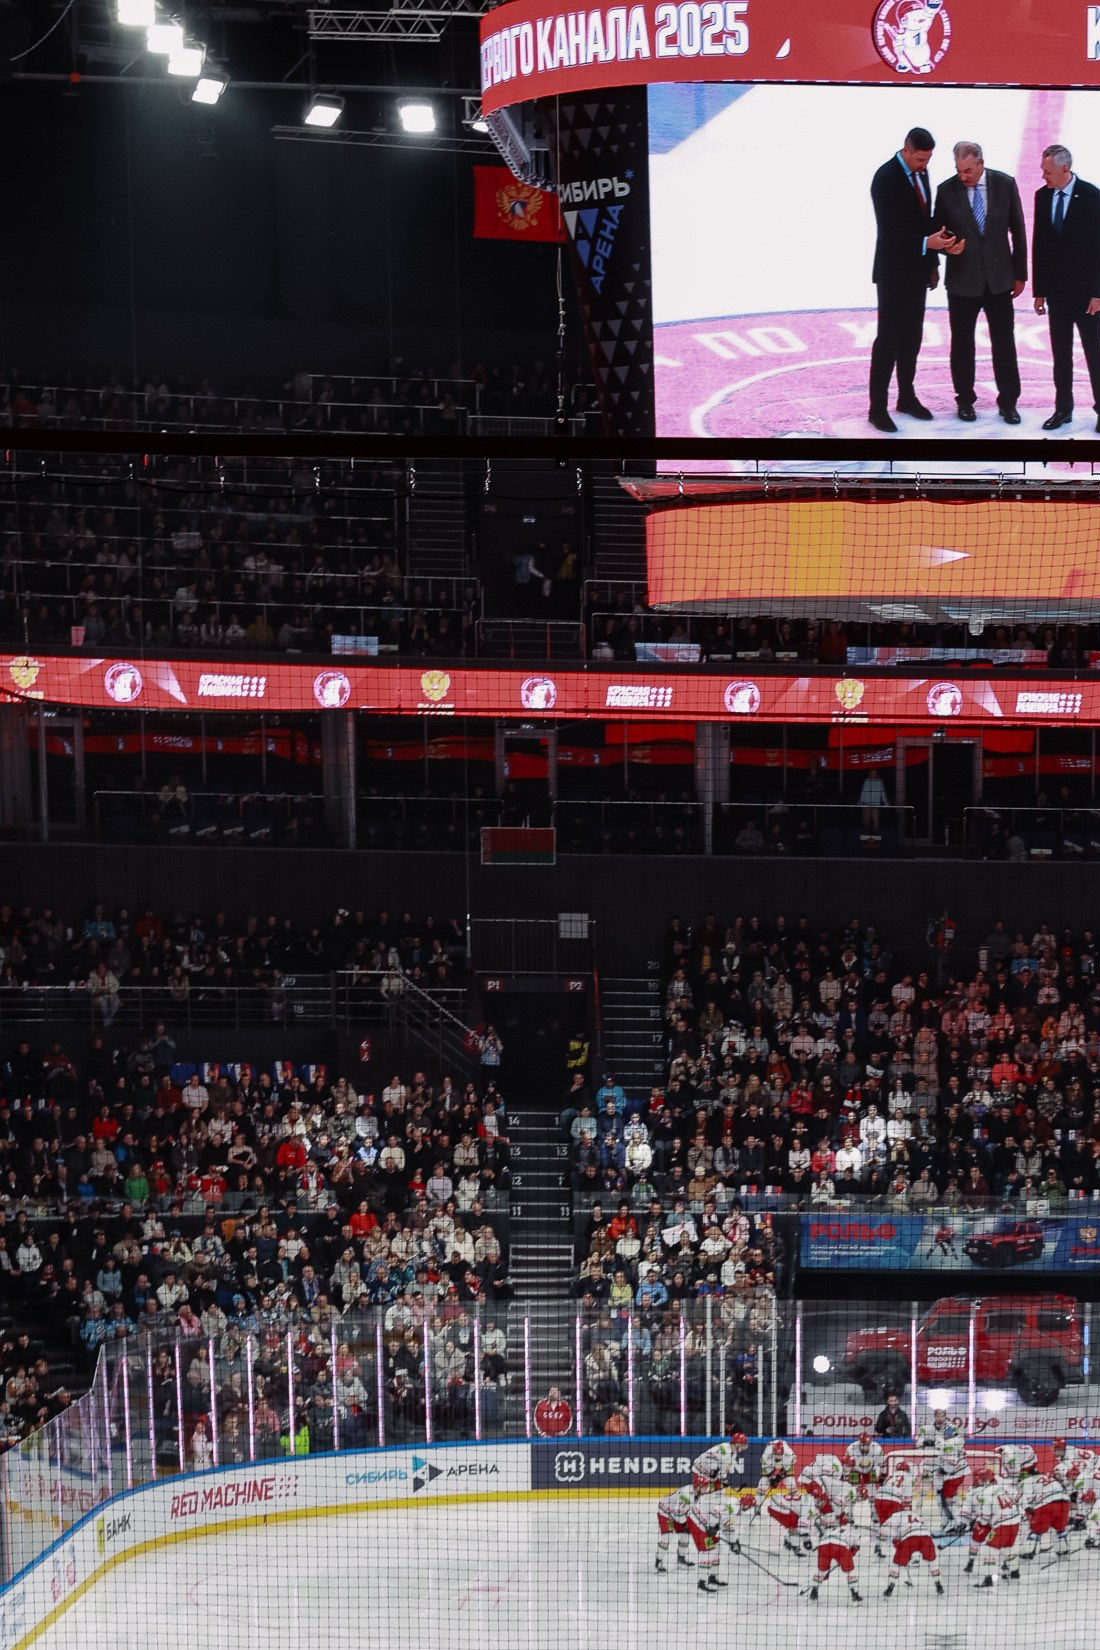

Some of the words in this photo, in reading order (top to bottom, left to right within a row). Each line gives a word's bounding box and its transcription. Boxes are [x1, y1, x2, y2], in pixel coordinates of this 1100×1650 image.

[480, 21, 534, 93] ЕРВОГО
[536, 5, 651, 73] КАНАЛА
[655, 1, 750, 58] 2025
[591, 204, 625, 295] АРЕНА
[810, 1222, 897, 1241] РОЛЬФ
[927, 1346, 967, 1356] РОЛЬФ
[812, 1415, 873, 1428] РОЛЬФ
[946, 1416, 1000, 1429] ОЛЬФ
[346, 1470, 408, 1486] СИБИРЬ
[446, 1463, 499, 1478] АРЕНА
[590, 1456, 745, 1474] HENDERN
[171, 1491, 199, 1519] RED
[201, 1477, 276, 1512] MACHINE
[106, 1513, 131, 1542] БАНК
